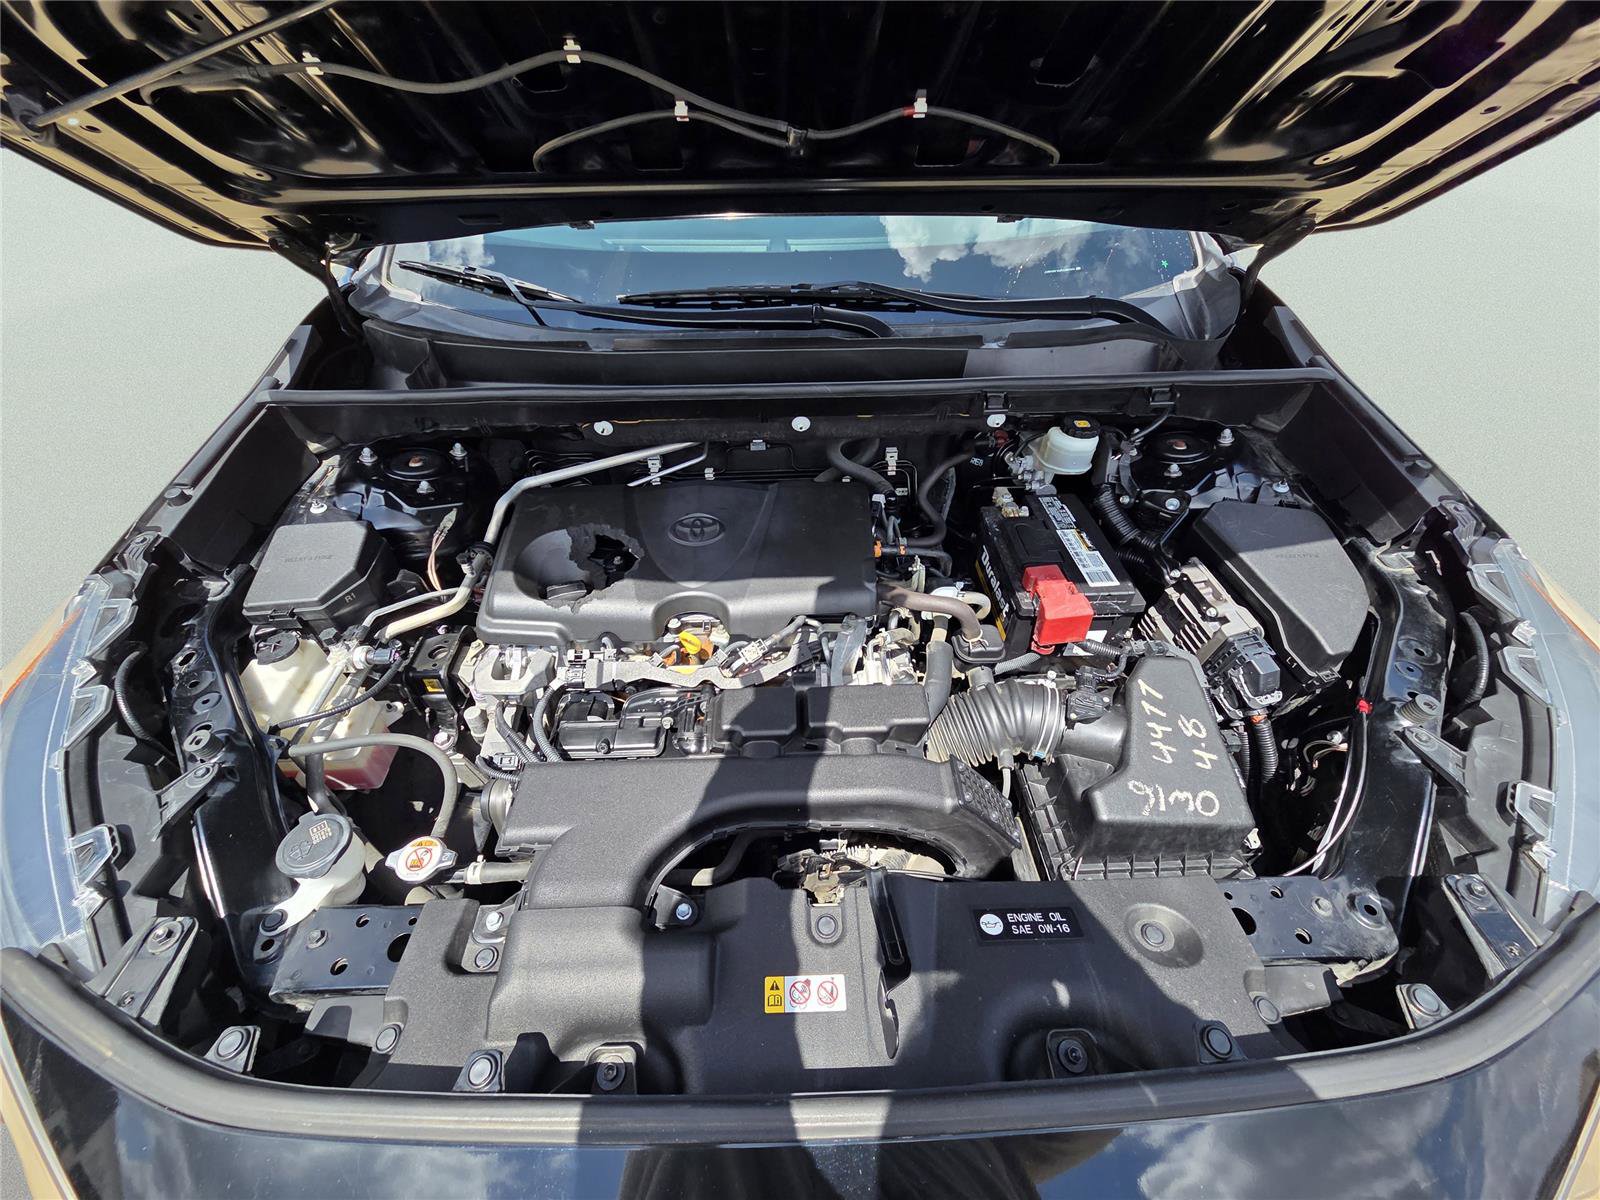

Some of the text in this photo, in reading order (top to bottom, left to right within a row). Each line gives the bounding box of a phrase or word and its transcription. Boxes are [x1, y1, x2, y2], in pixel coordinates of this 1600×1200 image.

[981, 545, 1010, 617] Duralast
[1006, 912, 1066, 922] ENGINE OIL
[1011, 924, 1033, 934] SAE
